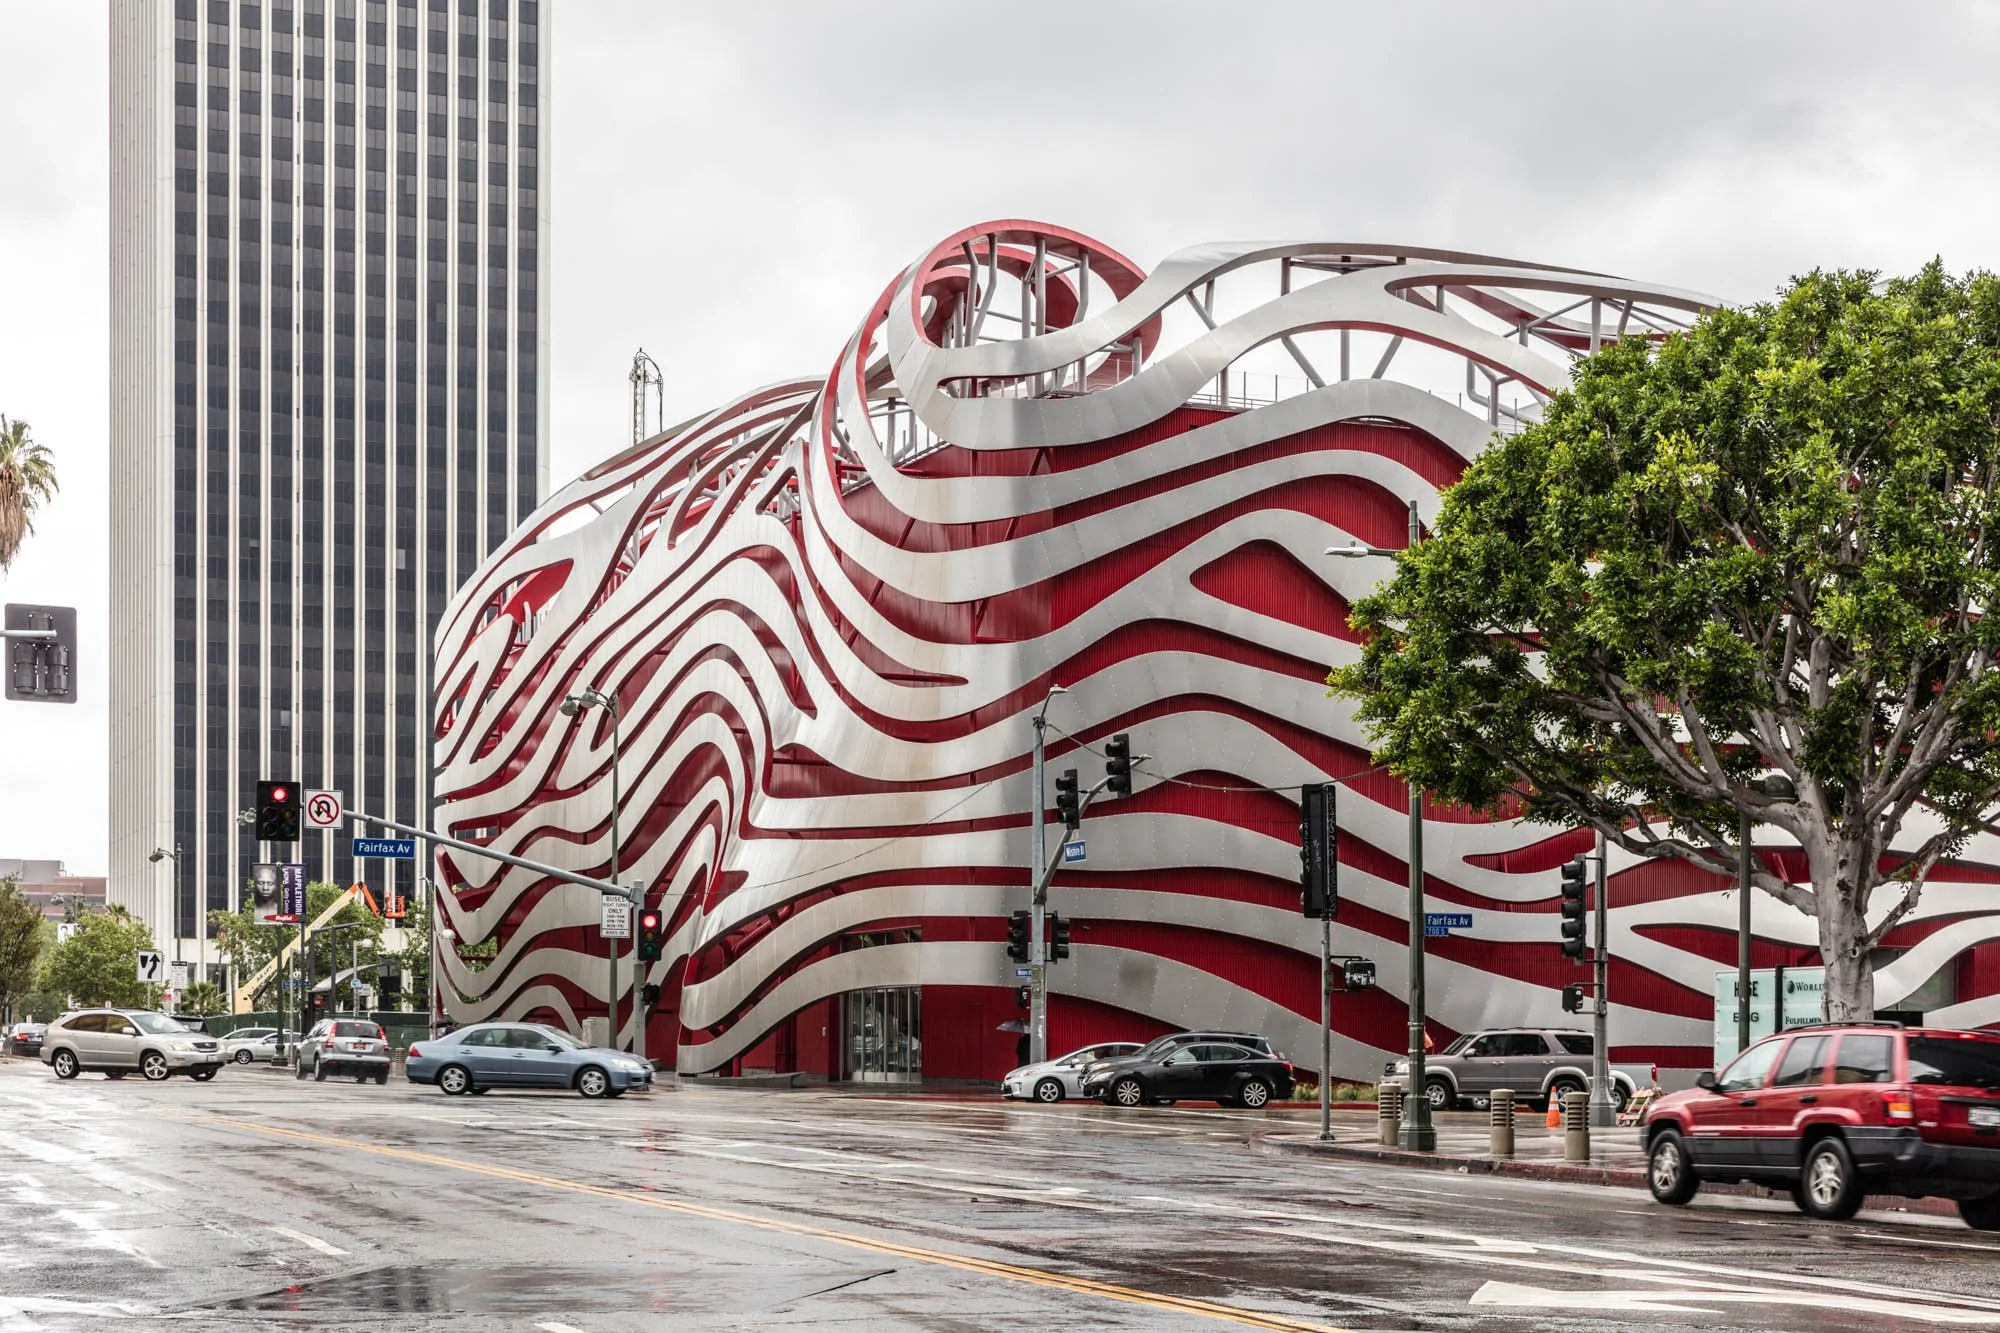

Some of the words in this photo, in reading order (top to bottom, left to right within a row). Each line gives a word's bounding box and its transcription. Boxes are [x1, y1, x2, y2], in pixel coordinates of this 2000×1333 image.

[358, 842, 395, 853] Fairfax
[396, 843, 410, 853] Av
[1427, 915, 1457, 926] Fairfax
[1459, 916, 1469, 926] Av
